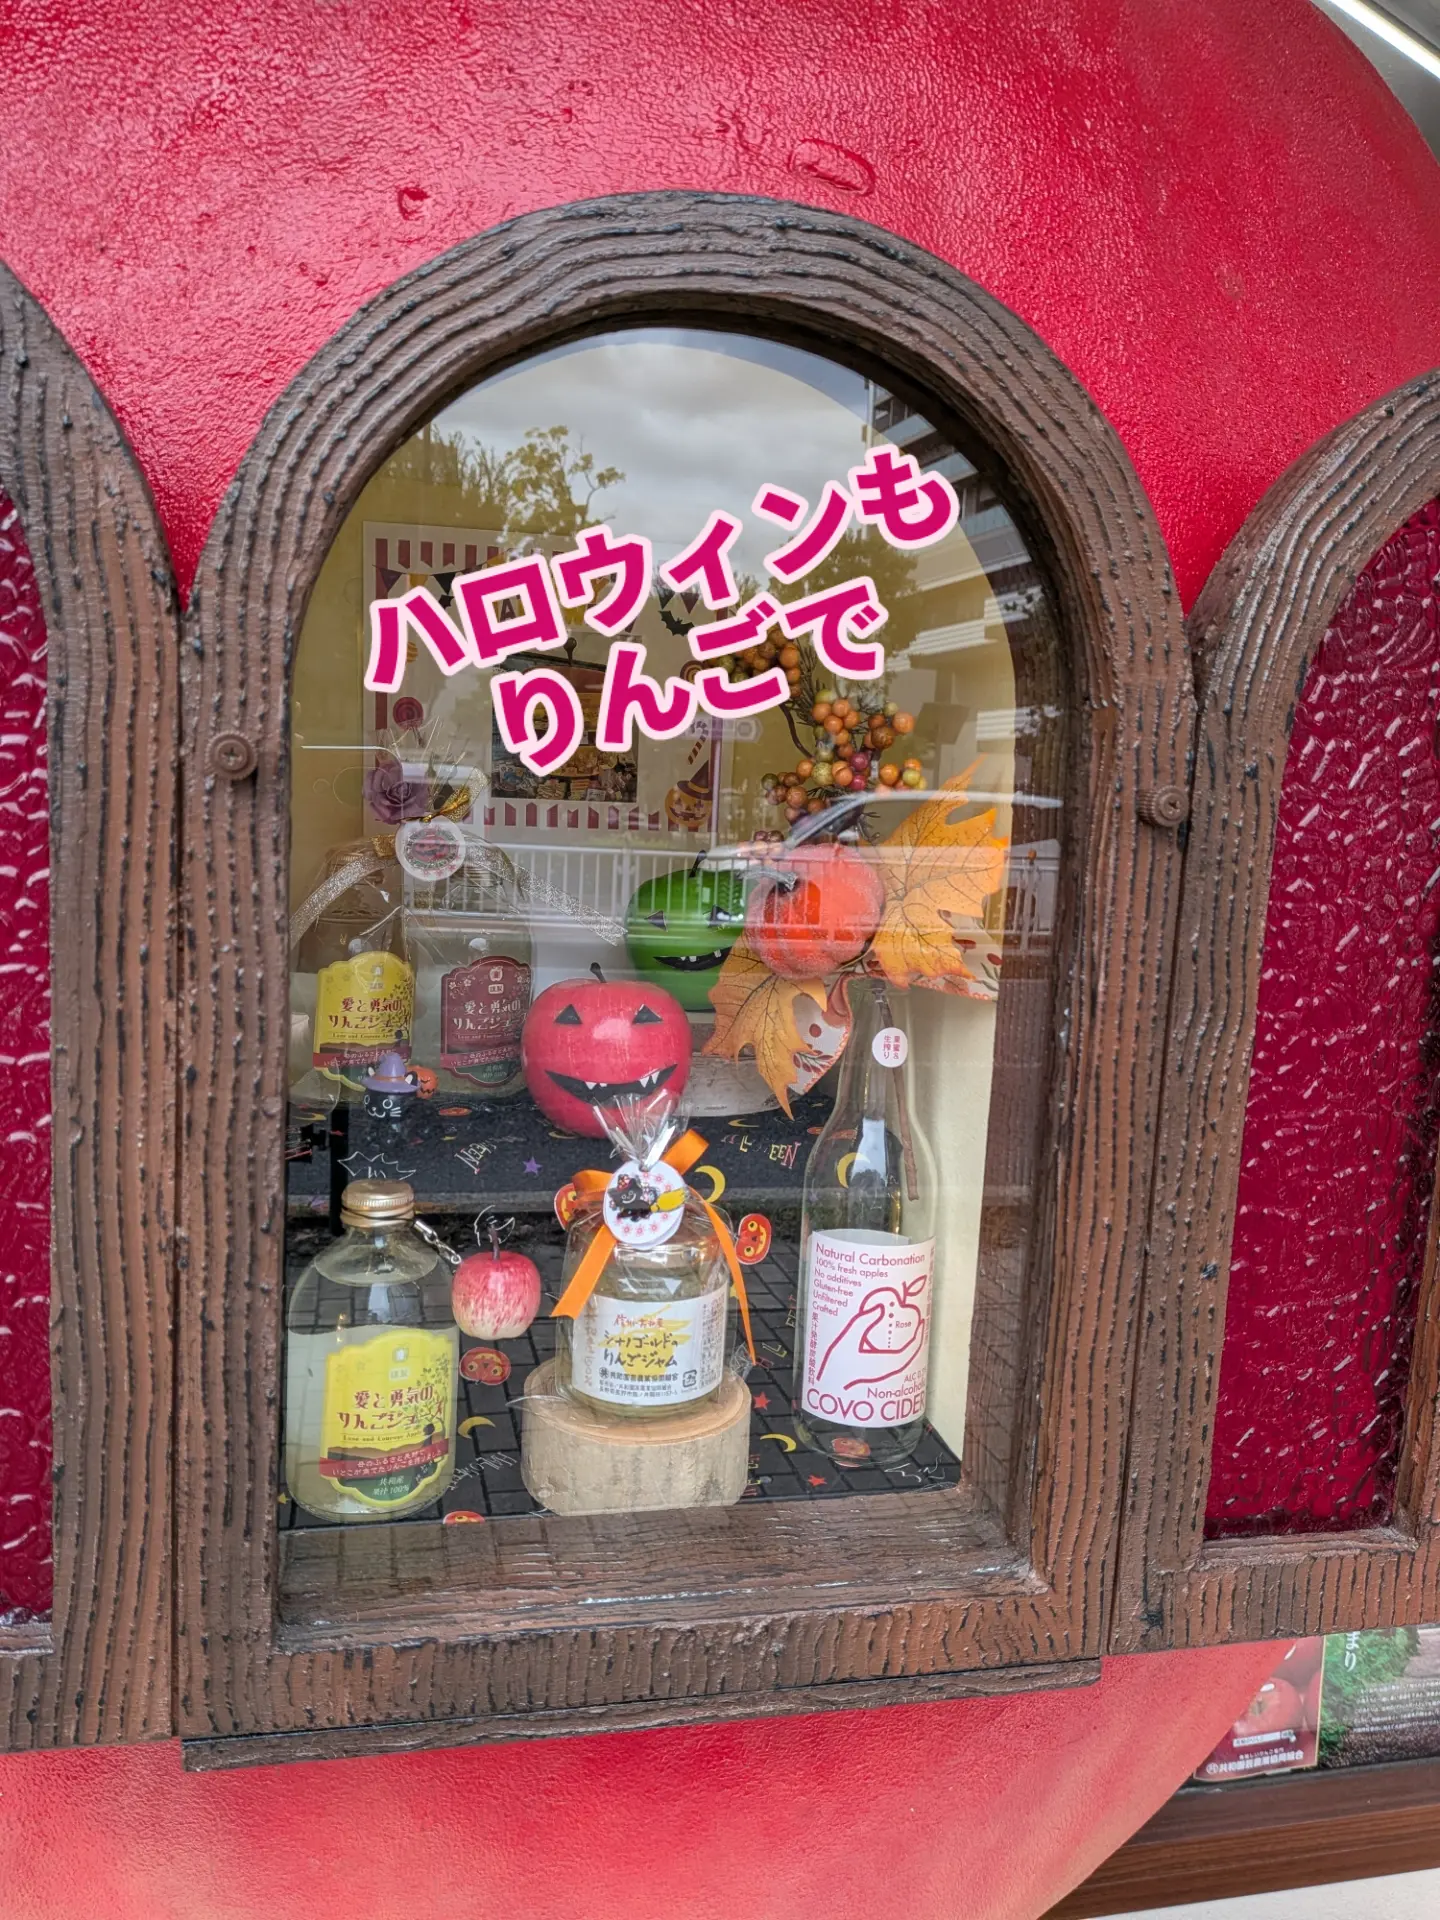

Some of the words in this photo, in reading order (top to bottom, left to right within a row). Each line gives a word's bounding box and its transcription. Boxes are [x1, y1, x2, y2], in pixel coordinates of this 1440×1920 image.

[816, 1242, 856, 1263] Natural
[859, 1252, 925, 1267] Carbonation
[814, 1267, 825, 1278] No
[826, 1272, 862, 1287] additives
[816, 1257, 836, 1271] 100%
[837, 1263, 857, 1275] fresh
[859, 1268, 888, 1279] apples
[813, 1279, 854, 1297] Gluten-free
[812, 1300, 839, 1317] Crafted
[813, 1289, 848, 1308] Unfiltered
[895, 1320, 912, 1329] Rose
[603, 1348, 679, 1369] りんごジャム
[354, 1385, 434, 1410] 愛と勇気の
[806, 1388, 875, 1421] COVO
[880, 1390, 925, 1421] CIDER
